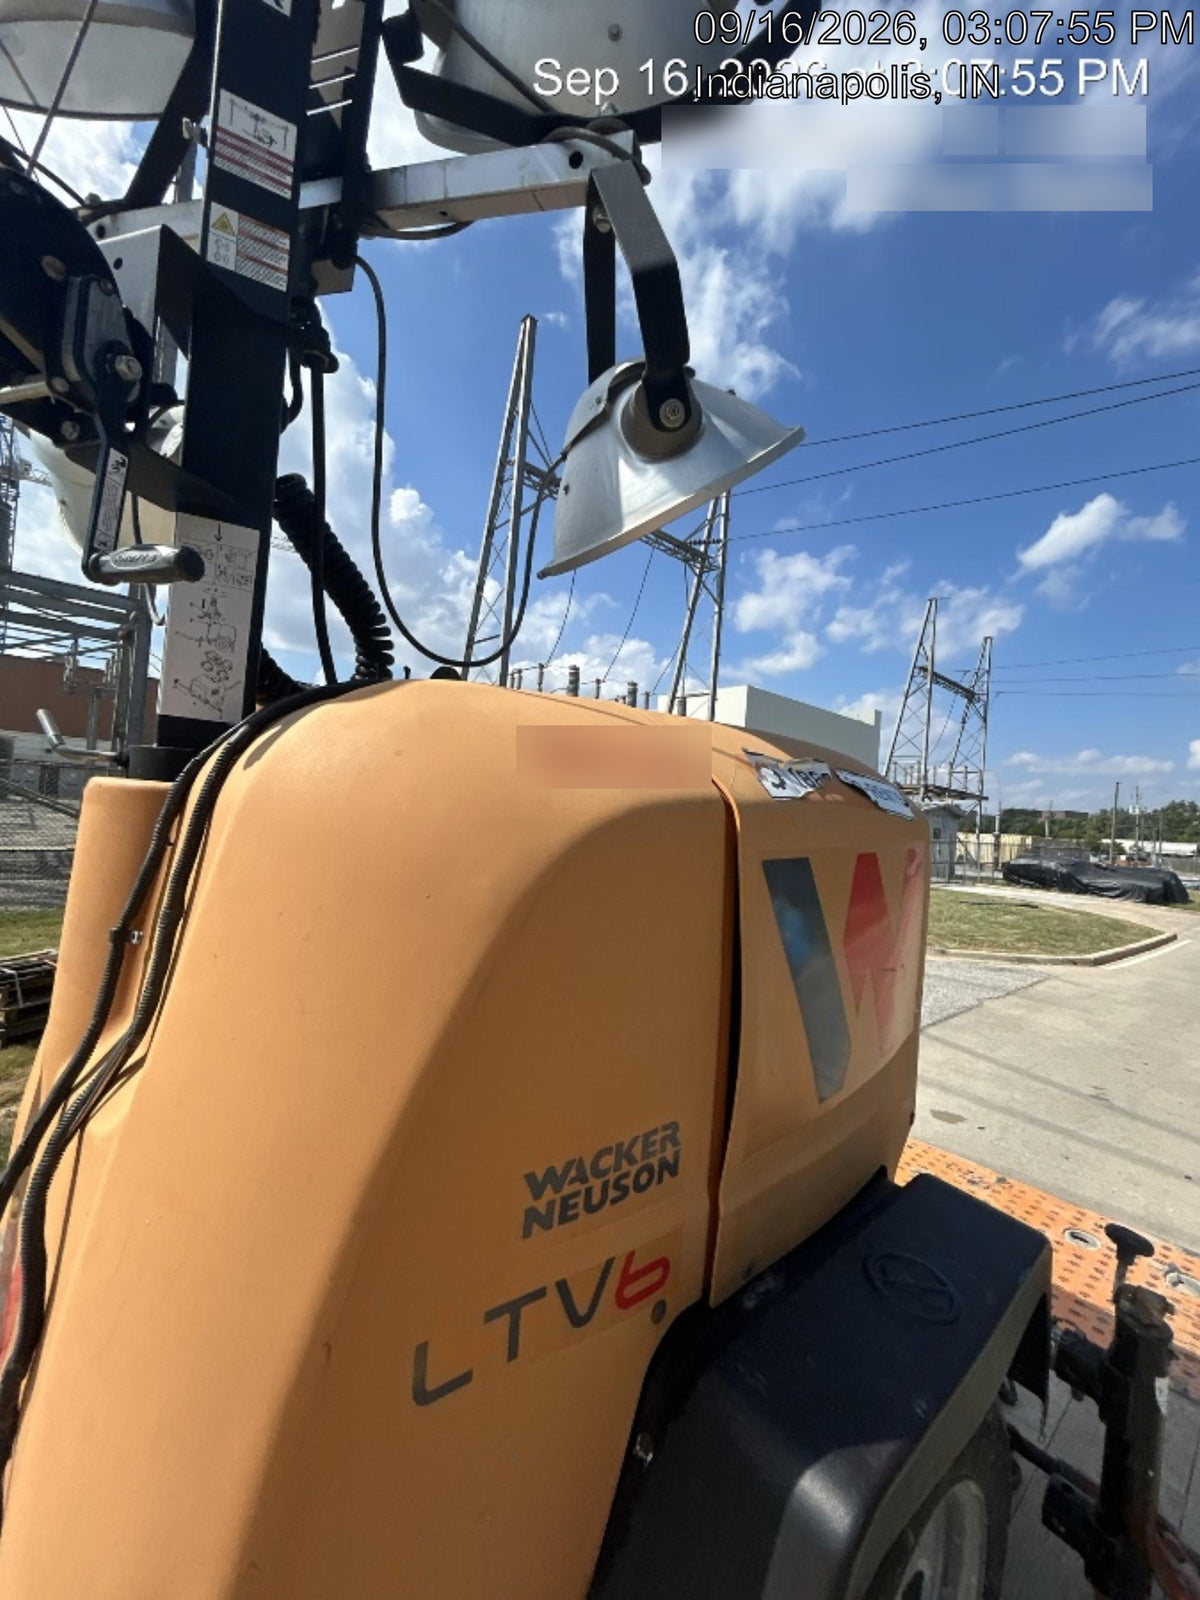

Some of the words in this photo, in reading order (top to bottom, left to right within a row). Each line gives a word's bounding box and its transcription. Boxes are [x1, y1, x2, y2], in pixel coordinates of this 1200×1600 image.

[521, 1148, 682, 1241] NEUSON
[523, 1120, 682, 1202] WACKER
[411, 1249, 672, 1408] LTV6
